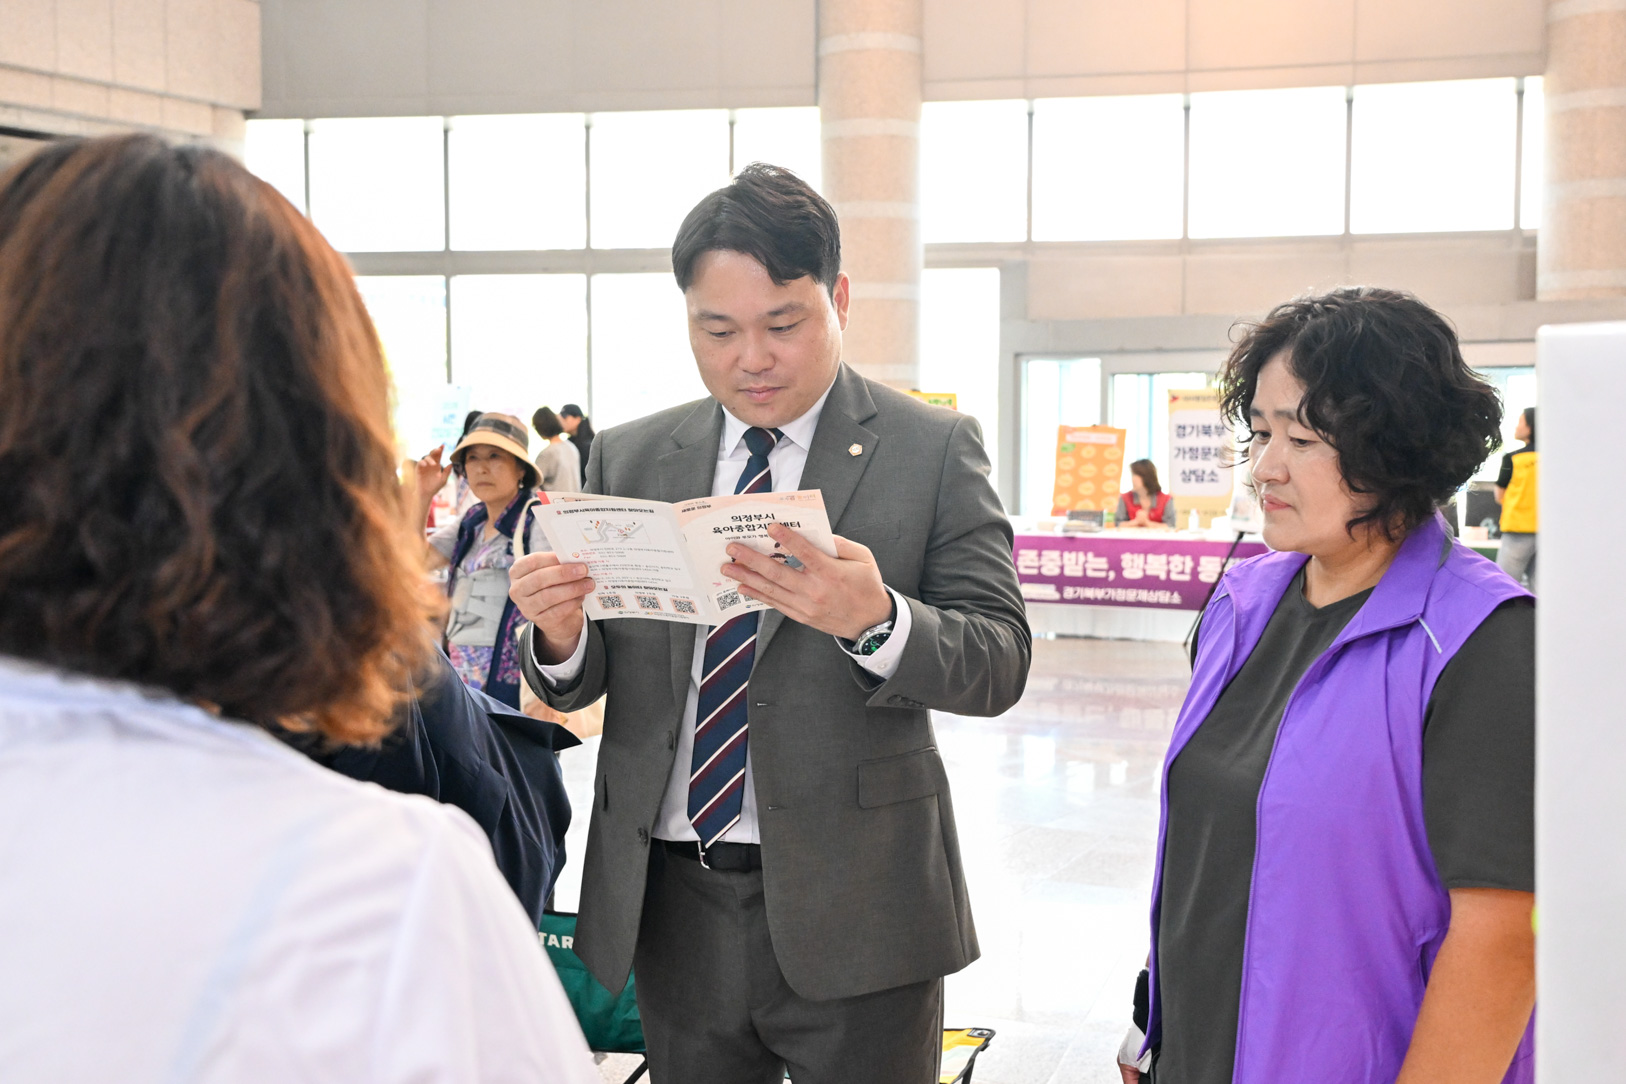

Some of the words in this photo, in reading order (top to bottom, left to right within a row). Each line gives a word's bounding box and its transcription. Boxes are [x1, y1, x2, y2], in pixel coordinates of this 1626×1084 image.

[1175, 424, 1226, 439] 경기북부
[1180, 468, 1219, 484] 상담소
[731, 513, 776, 523] 의정부시
[712, 521, 801, 535] 육아종합지센터
[1016, 549, 1116, 582] 존중받는,
[1120, 551, 1194, 581] 행복한
[1062, 586, 1182, 605] 경기북부가정문제상담소
